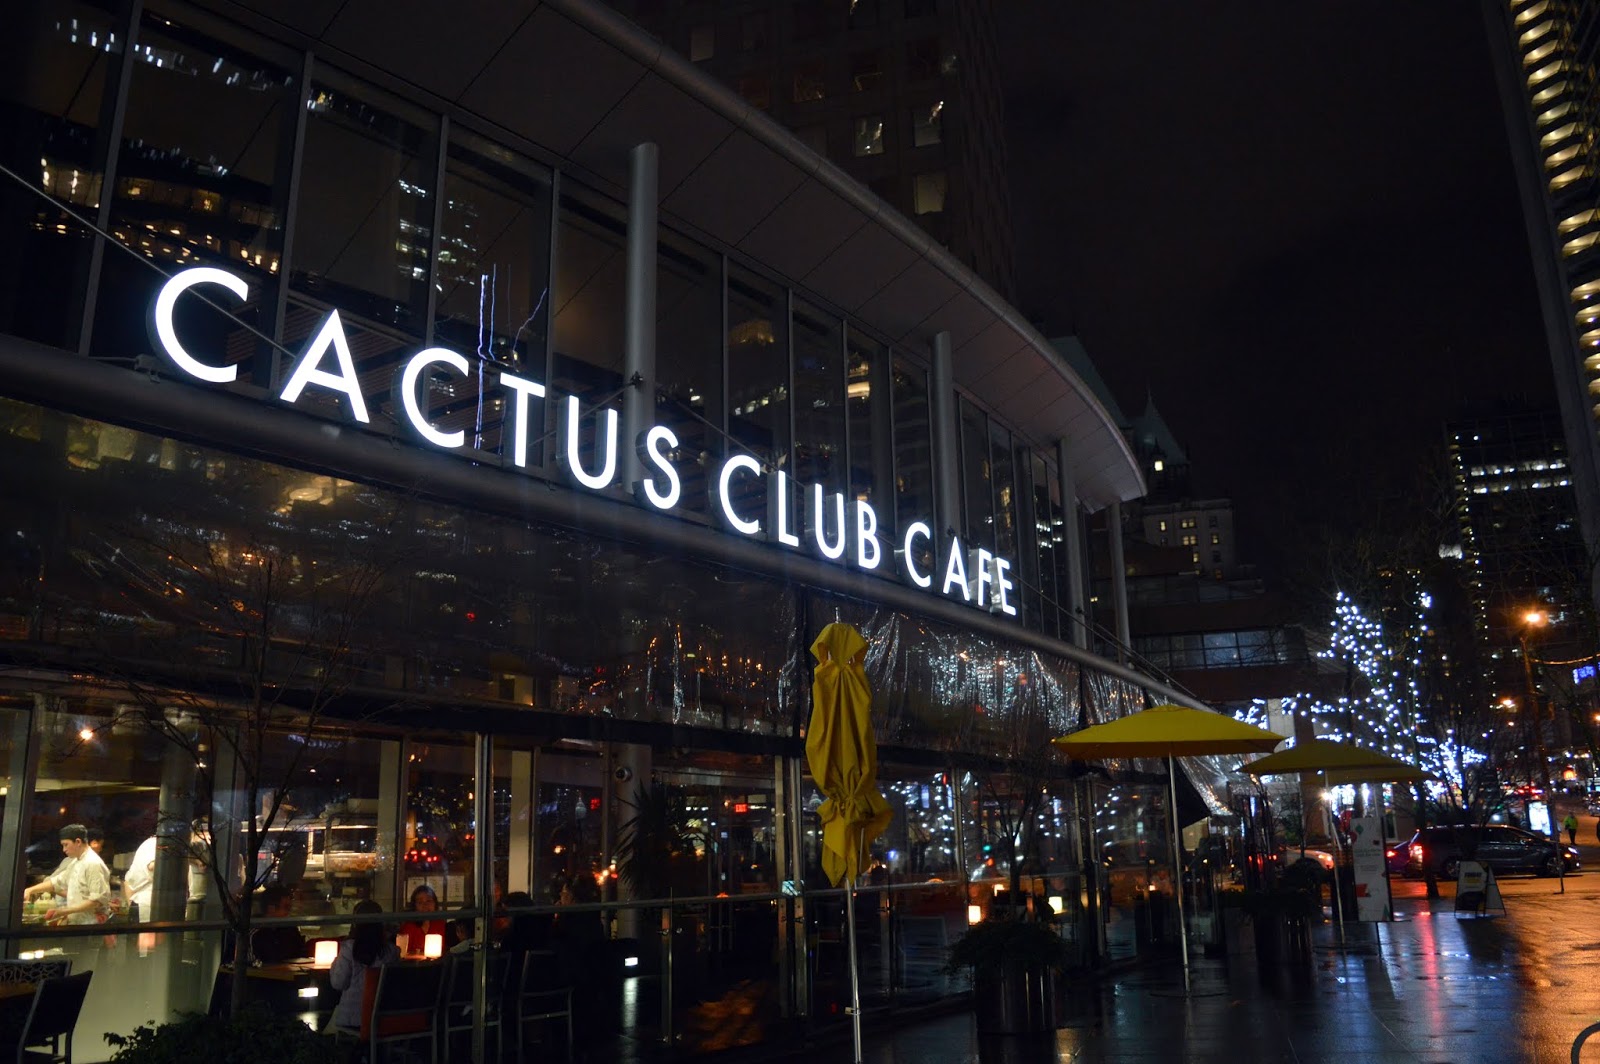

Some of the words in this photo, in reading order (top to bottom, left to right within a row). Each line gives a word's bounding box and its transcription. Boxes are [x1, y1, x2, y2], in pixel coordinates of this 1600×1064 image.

[154, 266, 682, 511] CACTUS
[718, 453, 883, 571] CLUB
[903, 520, 1018, 617] CAFE
